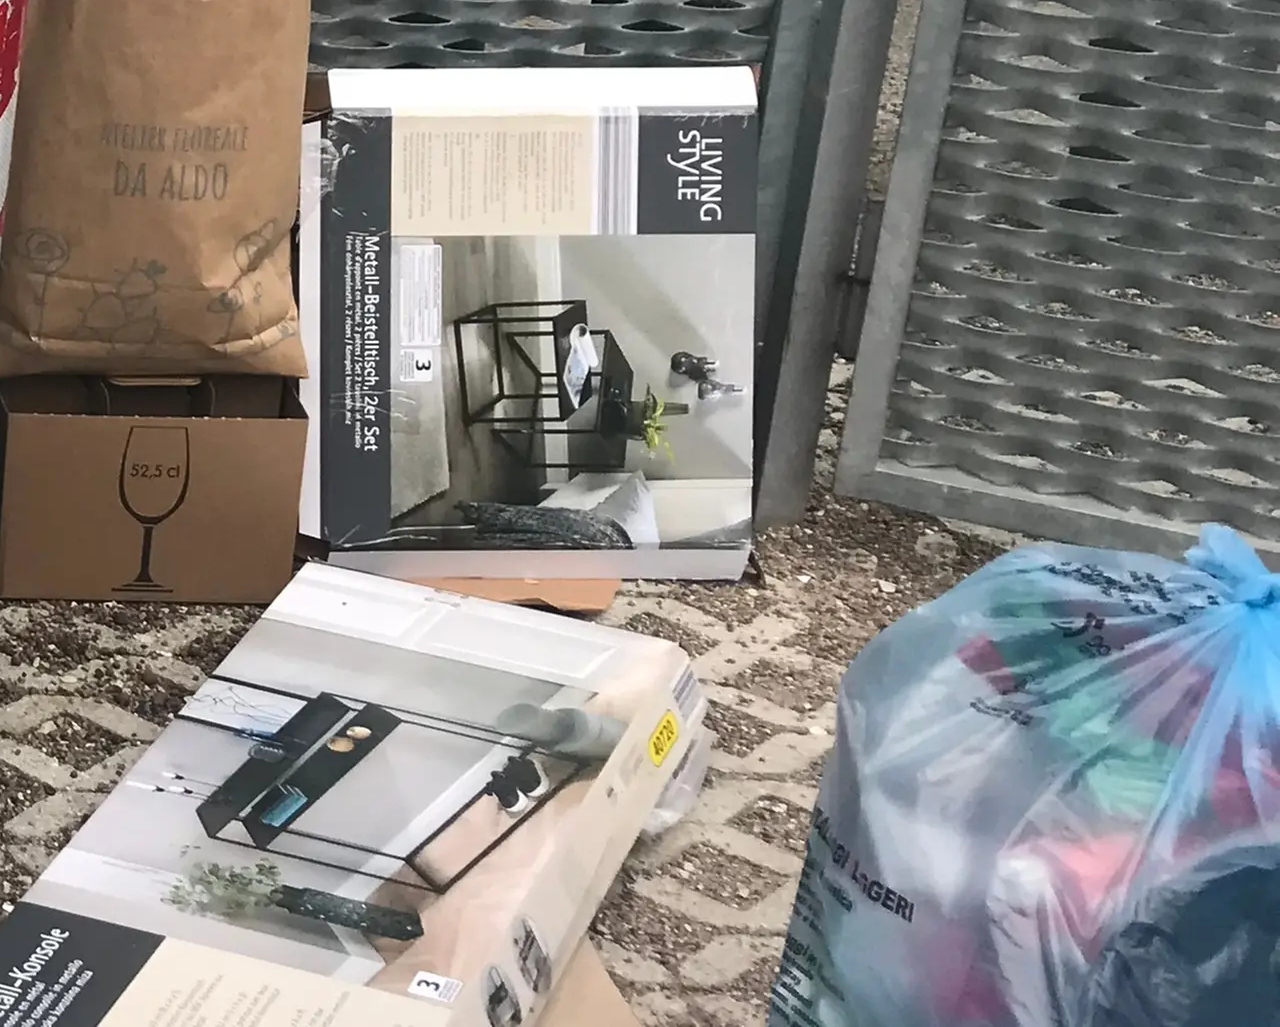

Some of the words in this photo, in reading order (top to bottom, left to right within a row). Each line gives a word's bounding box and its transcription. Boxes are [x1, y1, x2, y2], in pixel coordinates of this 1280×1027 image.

[113, 159, 147, 198] DA
[160, 162, 229, 202] ALDO
[700, 137, 723, 222] LIVING
[364, 236, 380, 390] Metall-Beistelltisch,
[415, 359, 432, 372] 3
[364, 426, 380, 452] Set
[130, 463, 163, 480] 52,5
[166, 464, 180, 479] cl
[416, 979, 440, 993] 3
